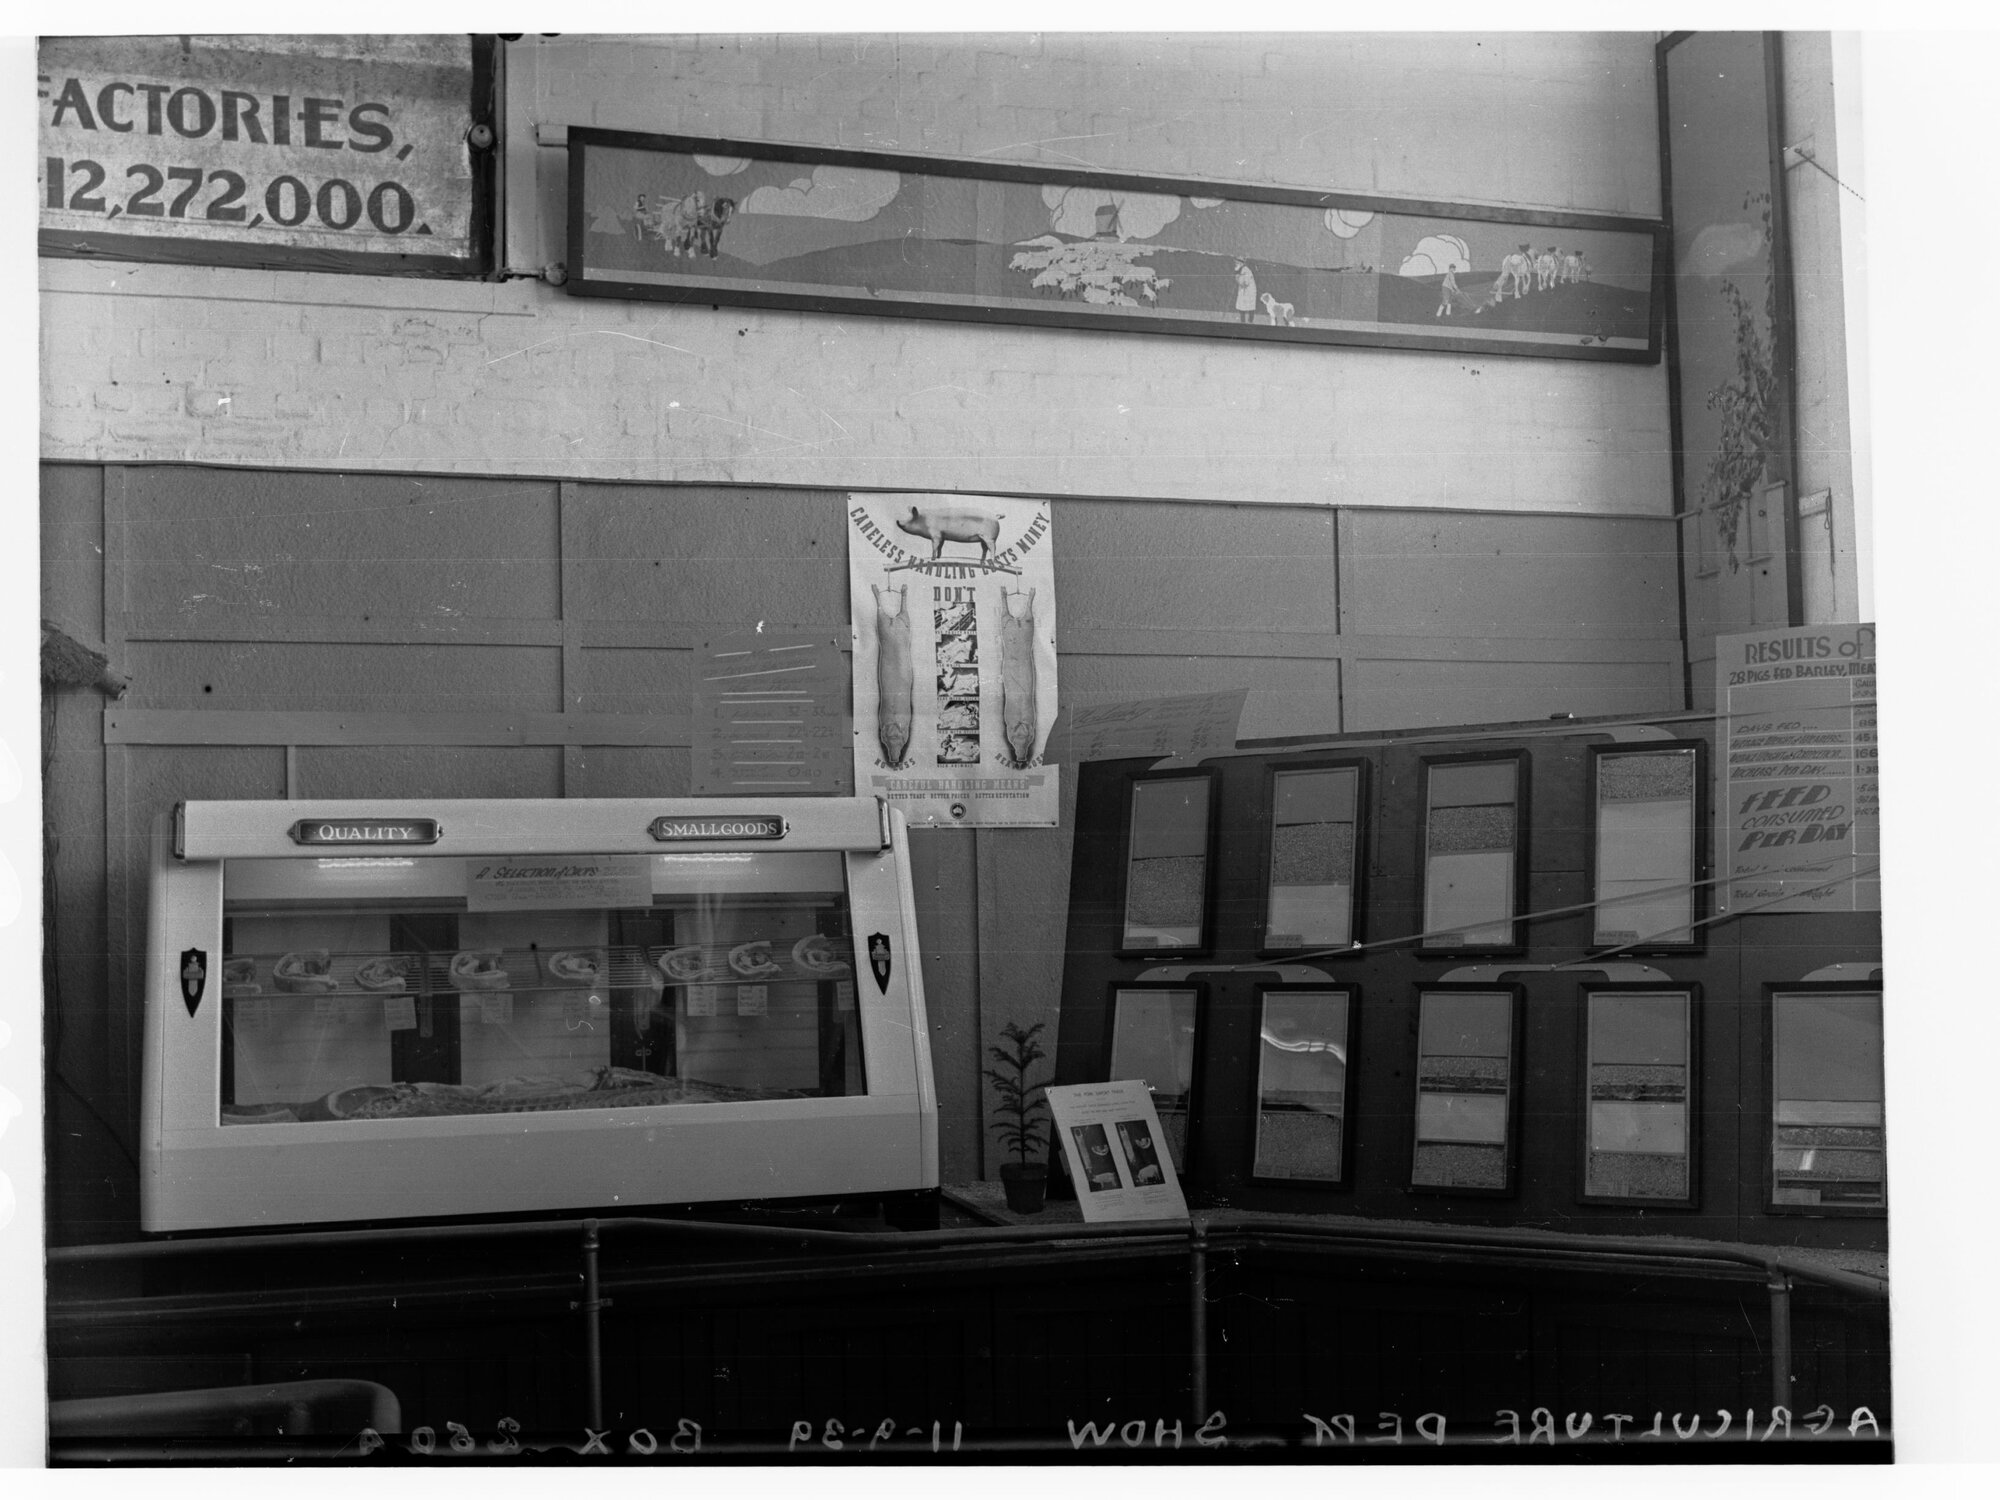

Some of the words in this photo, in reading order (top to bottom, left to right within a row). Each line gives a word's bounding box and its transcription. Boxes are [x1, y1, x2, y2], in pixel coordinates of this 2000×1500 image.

[38, 157, 432, 235] 12,272,000.
[850, 506, 905, 563] CARELESS
[907, 555, 976, 580] HANDLING
[981, 548, 1018, 576] COSTS
[1016, 512, 1051, 555] MONEY
[933, 586, 976, 603] DON'T
[1745, 636, 1831, 664] RESULTS
[1729, 672, 1746, 685] 28
[1747, 670, 1769, 682] PIGS
[1774, 668, 1793, 679] FED
[1796, 664, 1847, 677] BARLEY,
[1736, 722, 1772, 733] DAYS
[1776, 722, 1801, 730] FED
[1800, 765, 1827, 775] DAY
[890, 780, 932, 790] CAREFUL
[938, 779, 986, 790] HANDLING
[994, 779, 1025, 789] MEANS
[1739, 785, 1831, 814] FEED
[1741, 805, 1845, 830] CONSUMED
[319, 824, 412, 842] QUALITY
[662, 821, 777, 838] SMALLGOODS
[1738, 829, 1796, 852] PER
[1798, 820, 1854, 844] DAY
[494, 867, 557, 879] SELECTION
